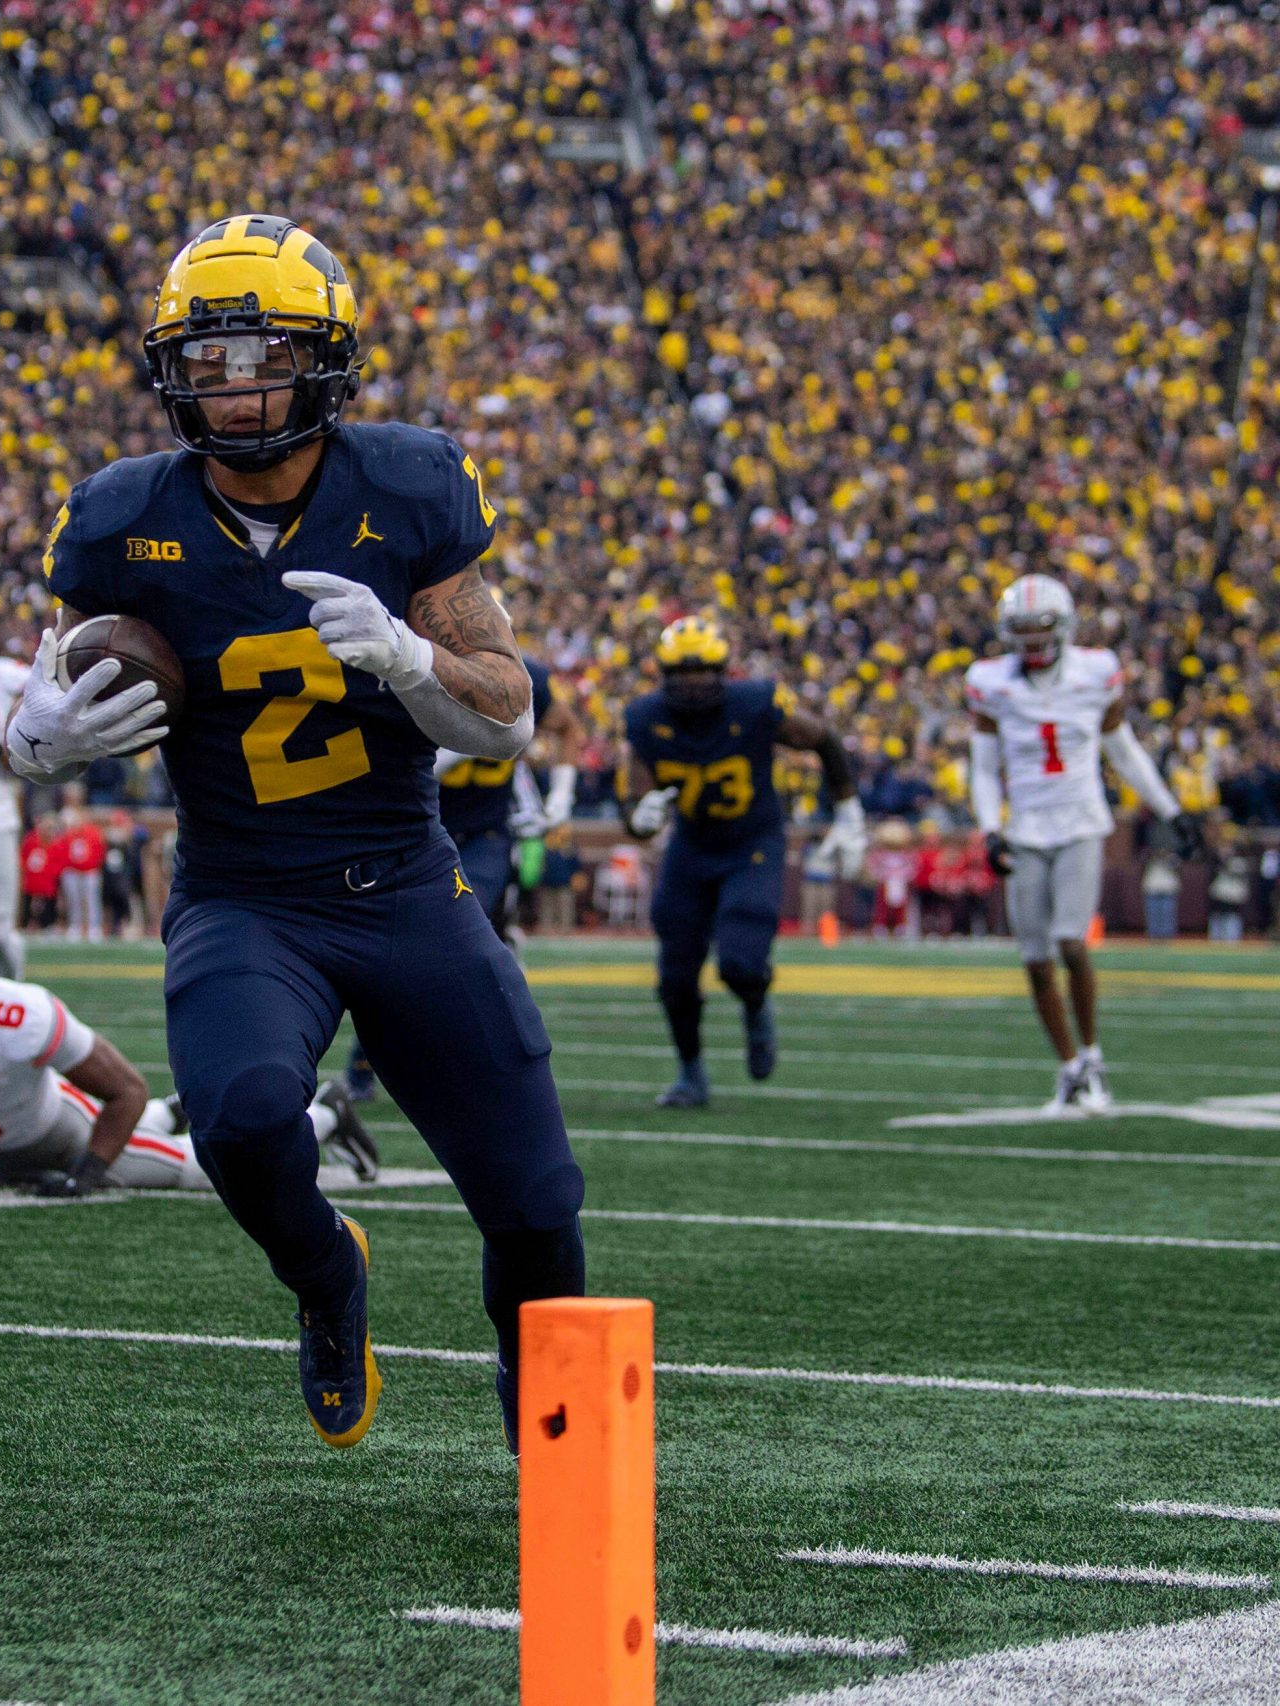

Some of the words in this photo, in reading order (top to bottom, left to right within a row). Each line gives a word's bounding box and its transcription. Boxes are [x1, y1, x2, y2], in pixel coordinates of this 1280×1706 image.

[219, 627, 372, 805] 2
[1039, 722, 1066, 775] 1
[655, 756, 754, 820] 73
[322, 1391, 341, 1407] M
